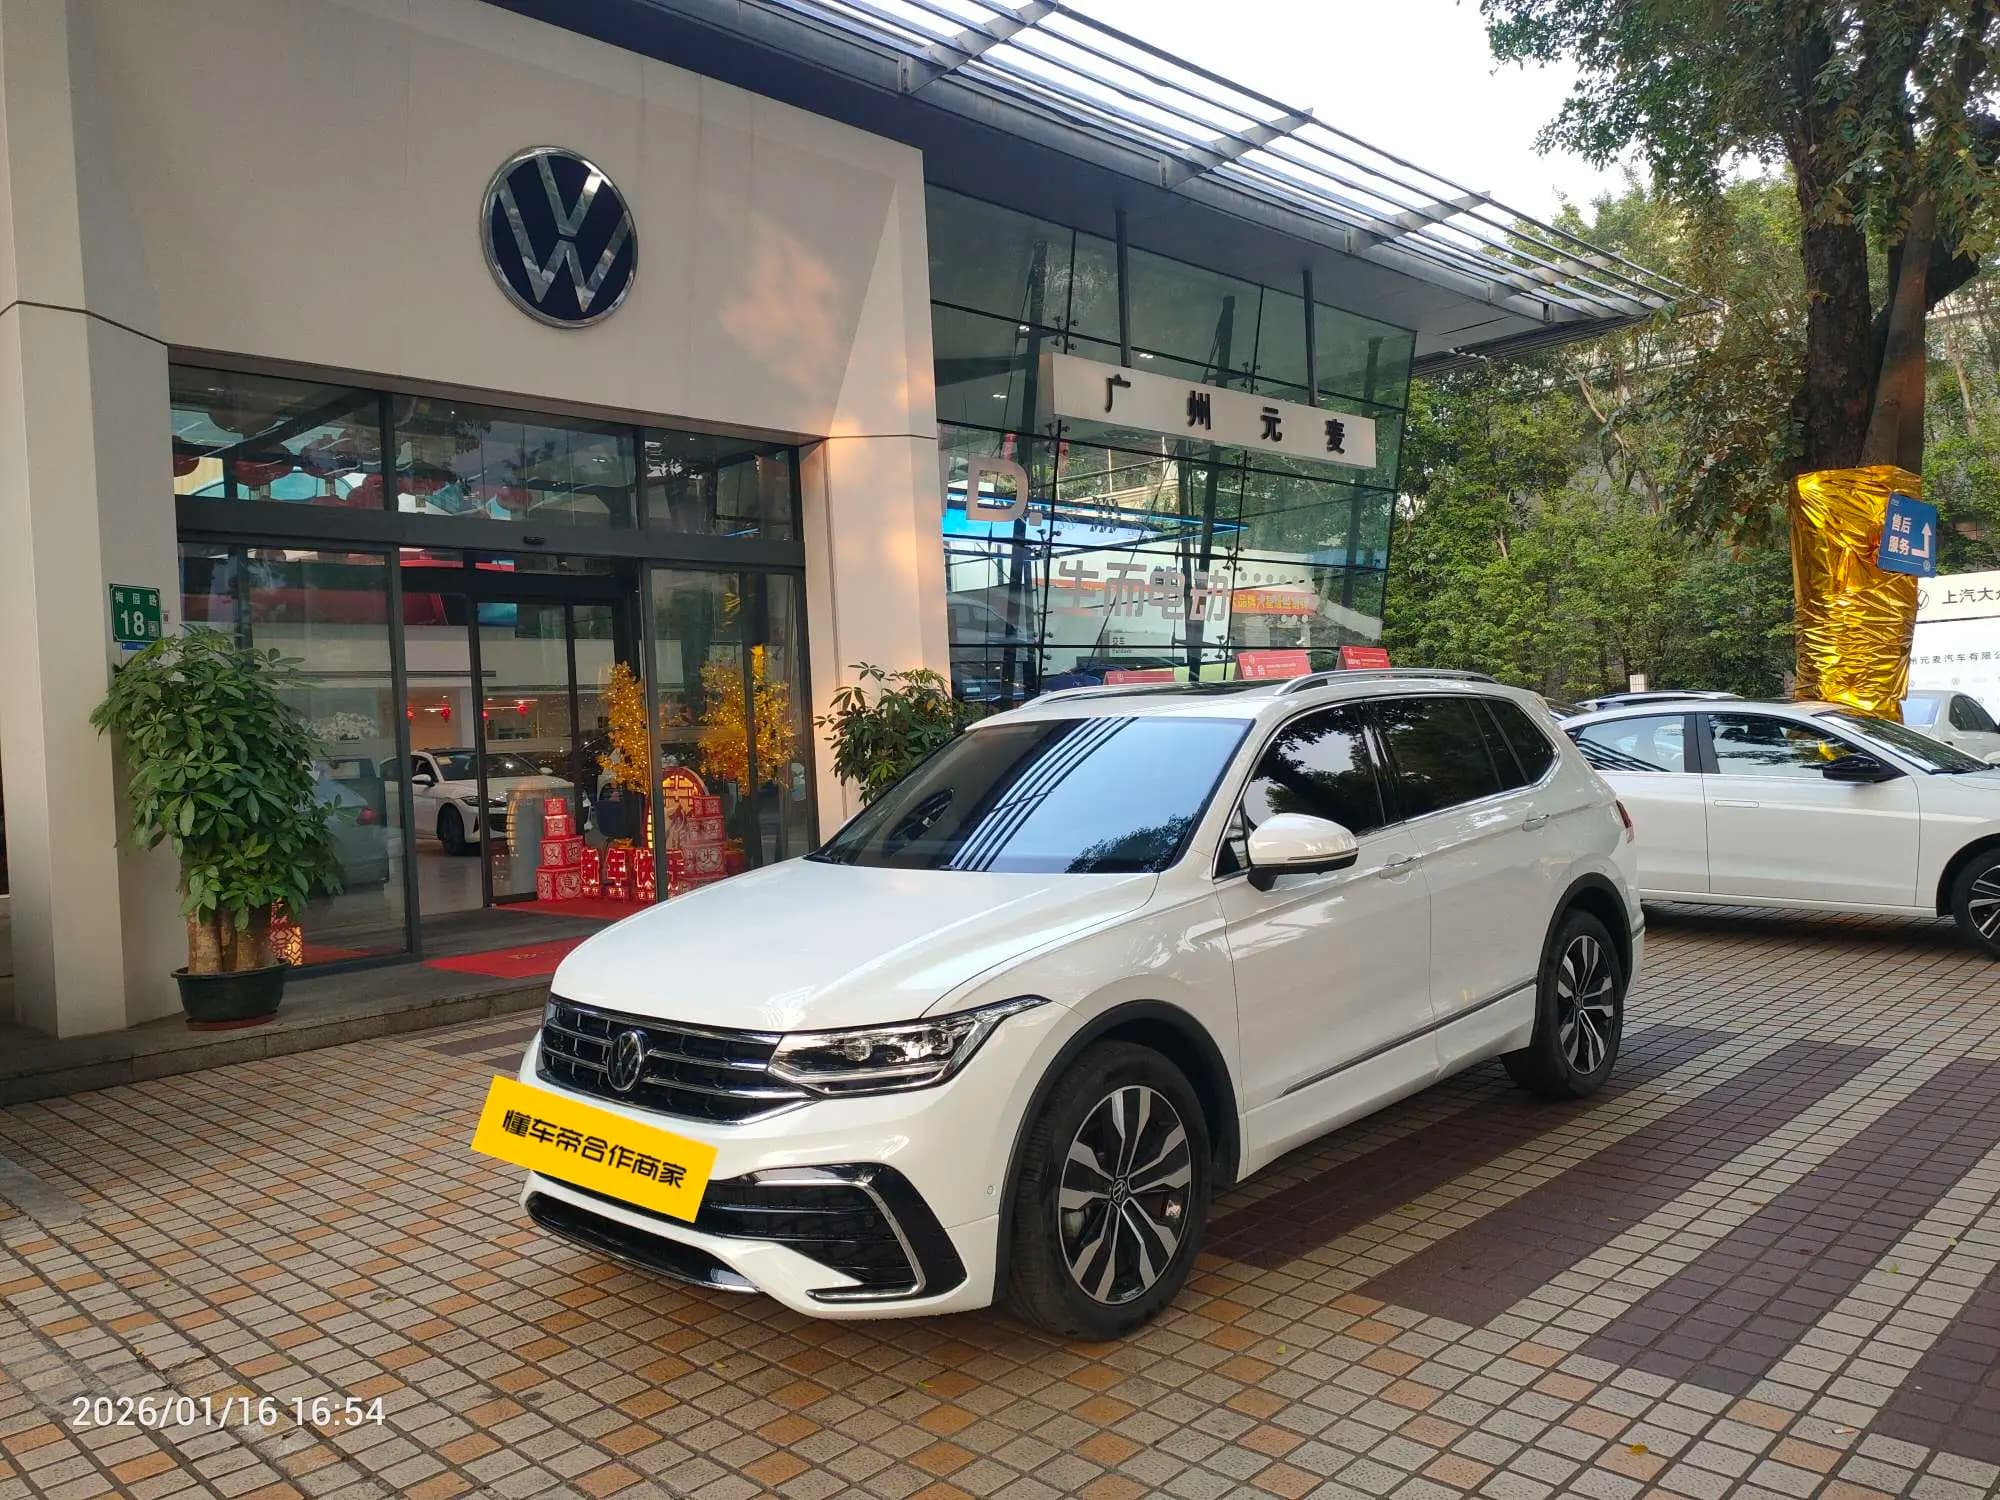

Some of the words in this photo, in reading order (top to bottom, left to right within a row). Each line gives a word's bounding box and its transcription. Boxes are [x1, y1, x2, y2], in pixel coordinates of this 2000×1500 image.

[1104, 374, 1345, 454] 广州元麦
[1892, 513, 1912, 535] 售后
[1888, 535, 1910, 556] 服务
[1056, 560, 1229, 622] 生而电动
[121, 610, 145, 636] 18
